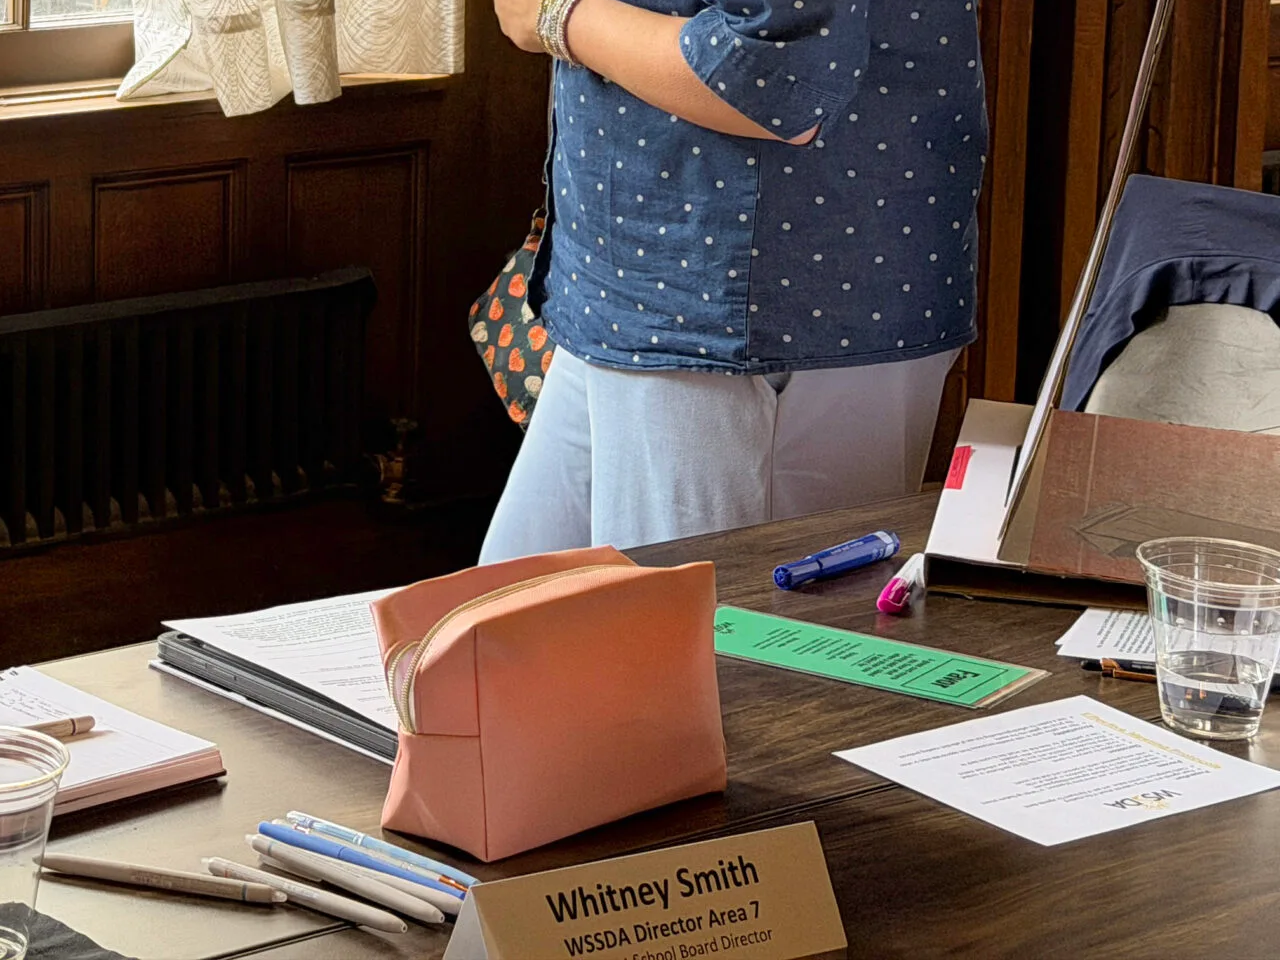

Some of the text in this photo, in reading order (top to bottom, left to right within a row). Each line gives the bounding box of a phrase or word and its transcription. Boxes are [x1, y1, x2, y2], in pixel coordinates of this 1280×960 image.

[546, 856, 759, 922] Whitney Smith
[564, 900, 760, 957] WSSDA Director Area 7
[679, 939, 719, 959] Board
[720, 928, 774, 951] Director
